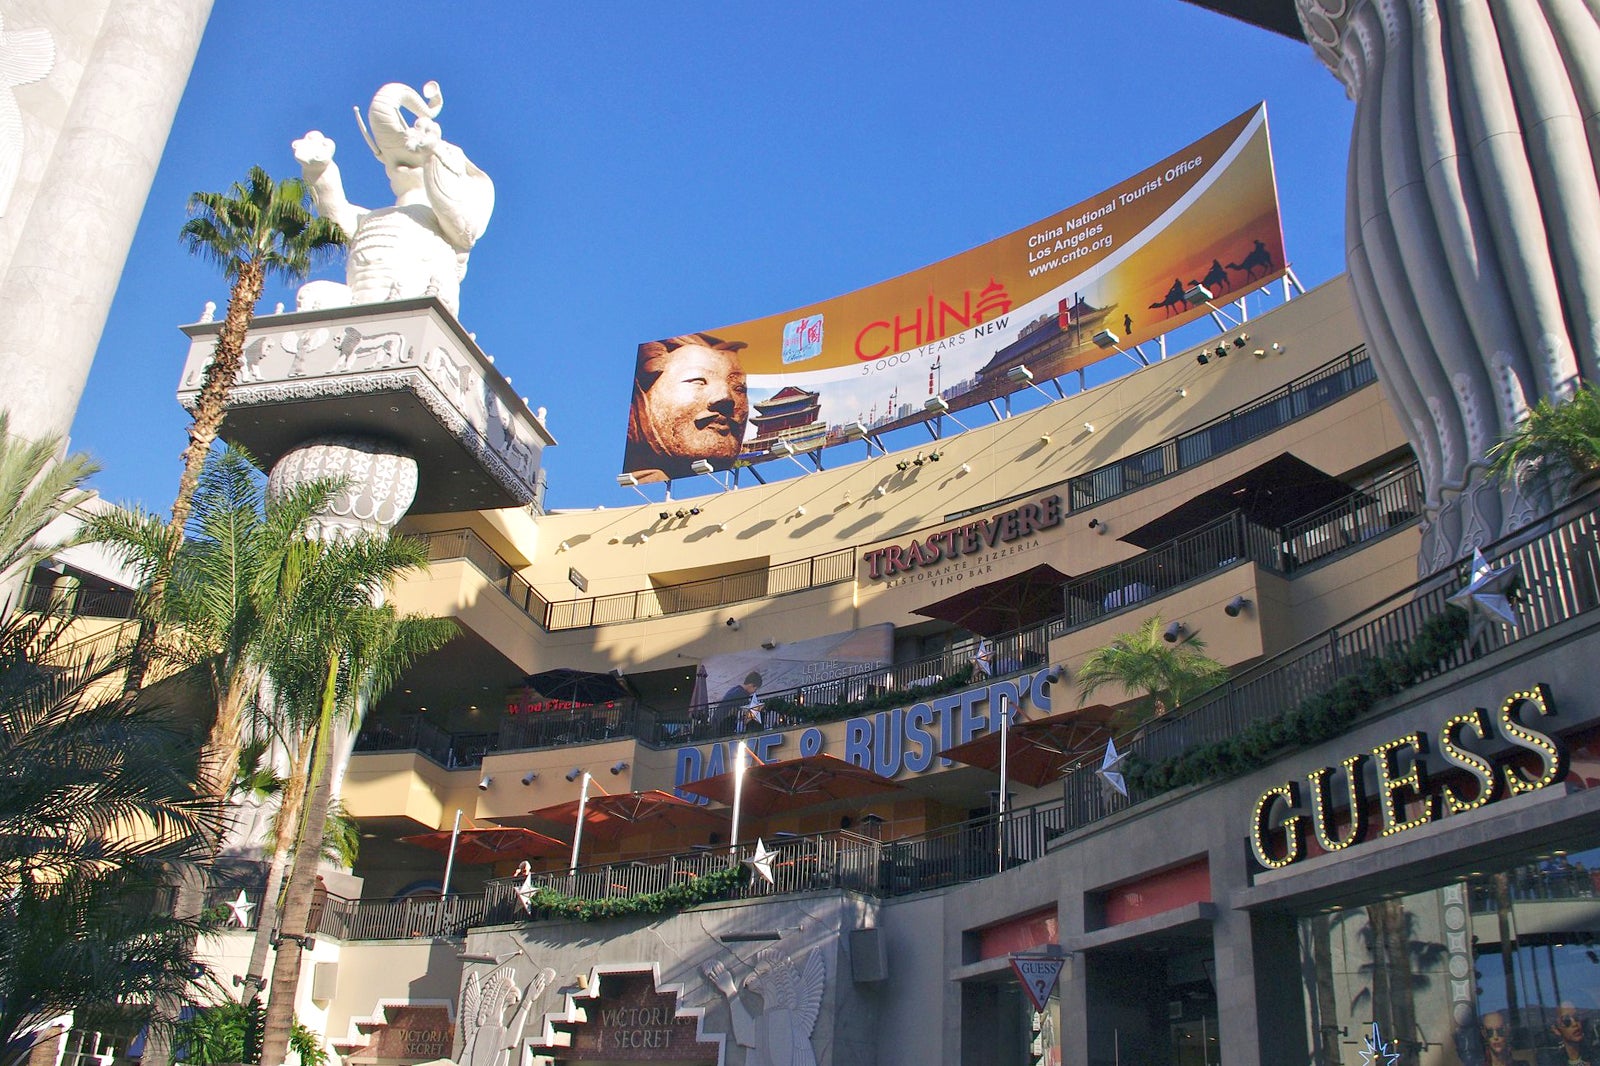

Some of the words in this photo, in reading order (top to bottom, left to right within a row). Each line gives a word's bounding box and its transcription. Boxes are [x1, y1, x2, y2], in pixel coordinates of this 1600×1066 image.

[1028, 226, 1062, 247] China
[1066, 200, 1116, 231] National
[1119, 176, 1162, 206] Tourist
[1165, 155, 1202, 182] Office
[1028, 234, 1113, 277] www.cnto.org
[1029, 248, 1051, 262] Los
[1054, 224, 1103, 252] Angeles
[855, 276, 1012, 361] CHINA
[862, 352, 911, 376] 5,000
[918, 333, 966, 357] YEARS
[974, 317, 1010, 339] NEW
[863, 494, 1062, 579] TRASTEVERE
[886, 561, 967, 590] RISTORANTE
[977, 539, 1040, 564] PIZZERIA
[931, 573, 964, 588] VINO
[969, 565, 993, 578] BAR
[802, 663, 818, 675] LET
[821, 659, 838, 670] THE
[802, 660, 881, 685] UNFORGETTABLE
[845, 667, 1051, 779] BUSTER'S
[1250, 682, 1570, 870] GUESS
[1021, 963, 1057, 974] GUESS
[406, 1043, 444, 1055] SECRET
[614, 1030, 673, 1049] SECRET
